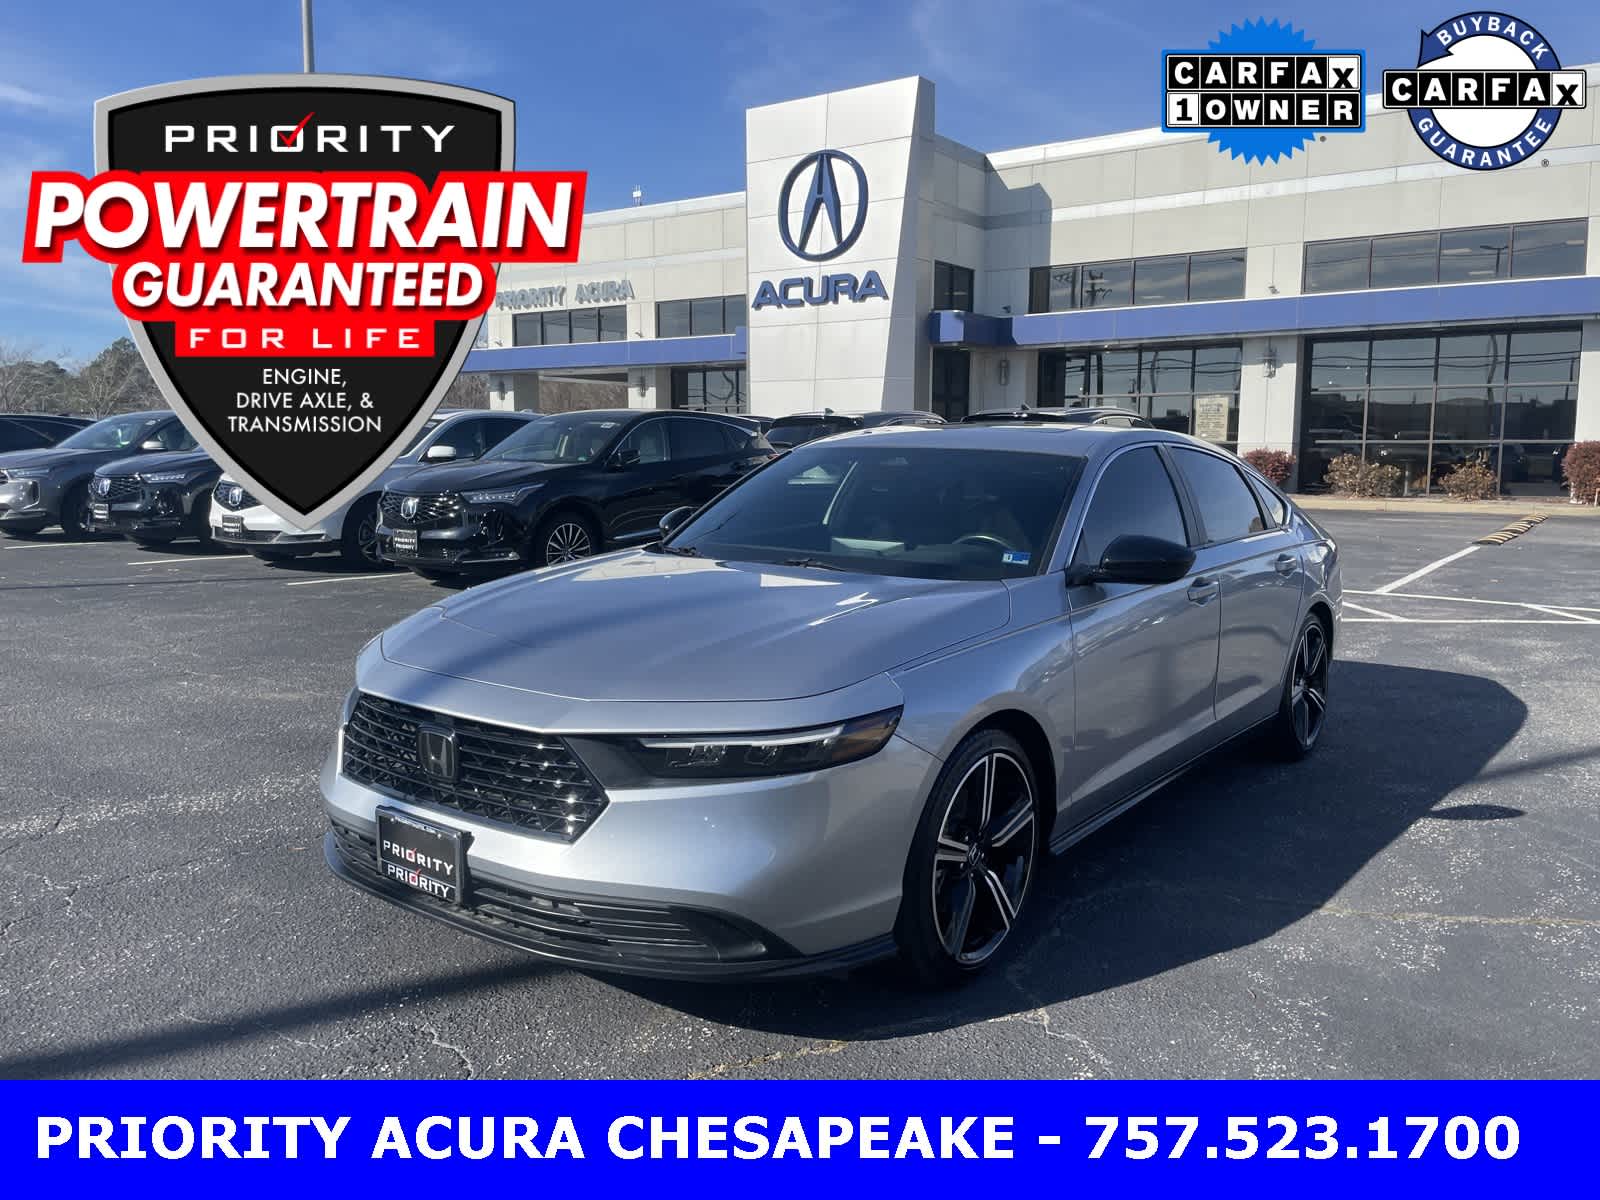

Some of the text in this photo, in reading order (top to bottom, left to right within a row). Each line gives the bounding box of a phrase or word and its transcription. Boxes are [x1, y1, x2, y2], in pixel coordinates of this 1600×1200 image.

[496, 279, 636, 311] PRIORITY ACURA
[751, 269, 890, 311] ACURA
[383, 840, 454, 875] PRIORITY
[388, 864, 449, 898] PRIORITY
